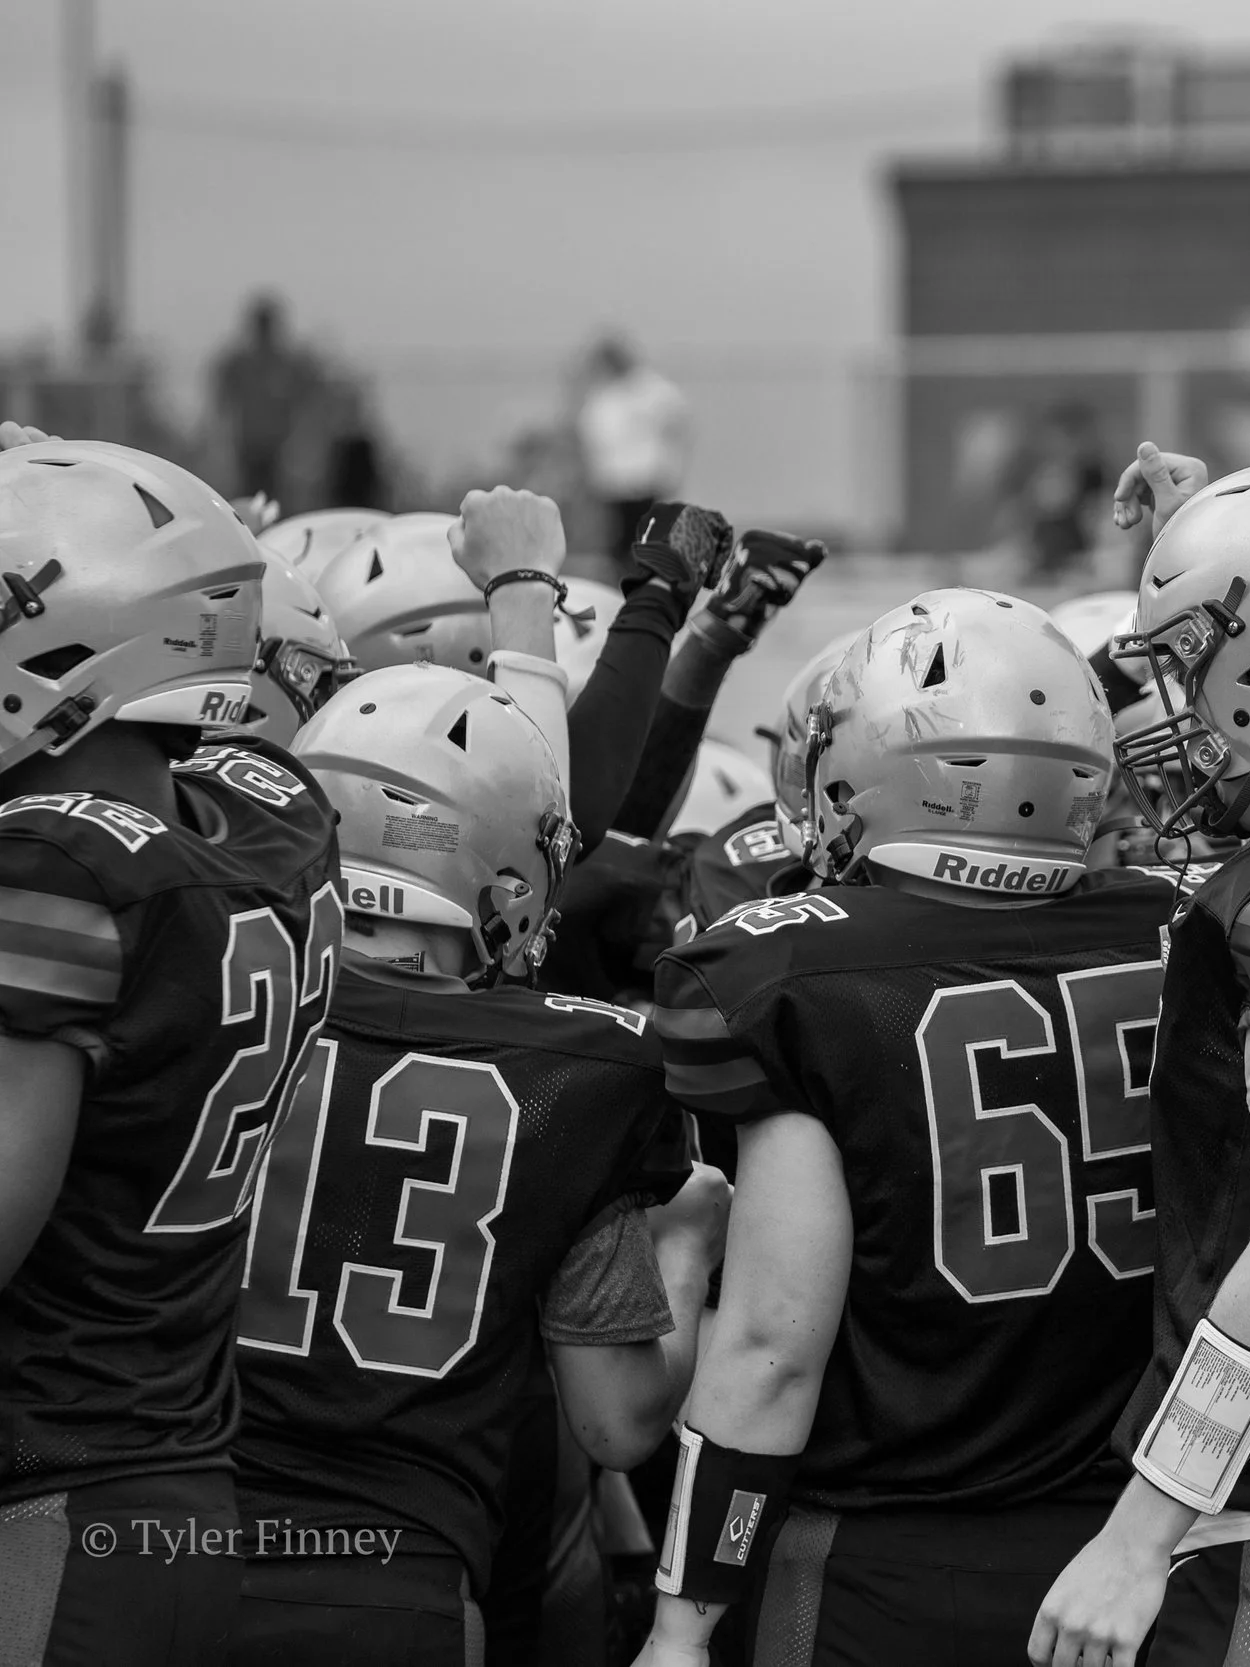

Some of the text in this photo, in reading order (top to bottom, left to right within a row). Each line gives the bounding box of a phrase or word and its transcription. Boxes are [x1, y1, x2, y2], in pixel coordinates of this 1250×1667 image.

[922, 799, 952, 814] Riddell
[932, 852, 1070, 893] Riddell
[914, 958, 1164, 1304] 65
[236, 1038, 520, 1380] 13
[736, 1497, 761, 1561] CUTTERS
